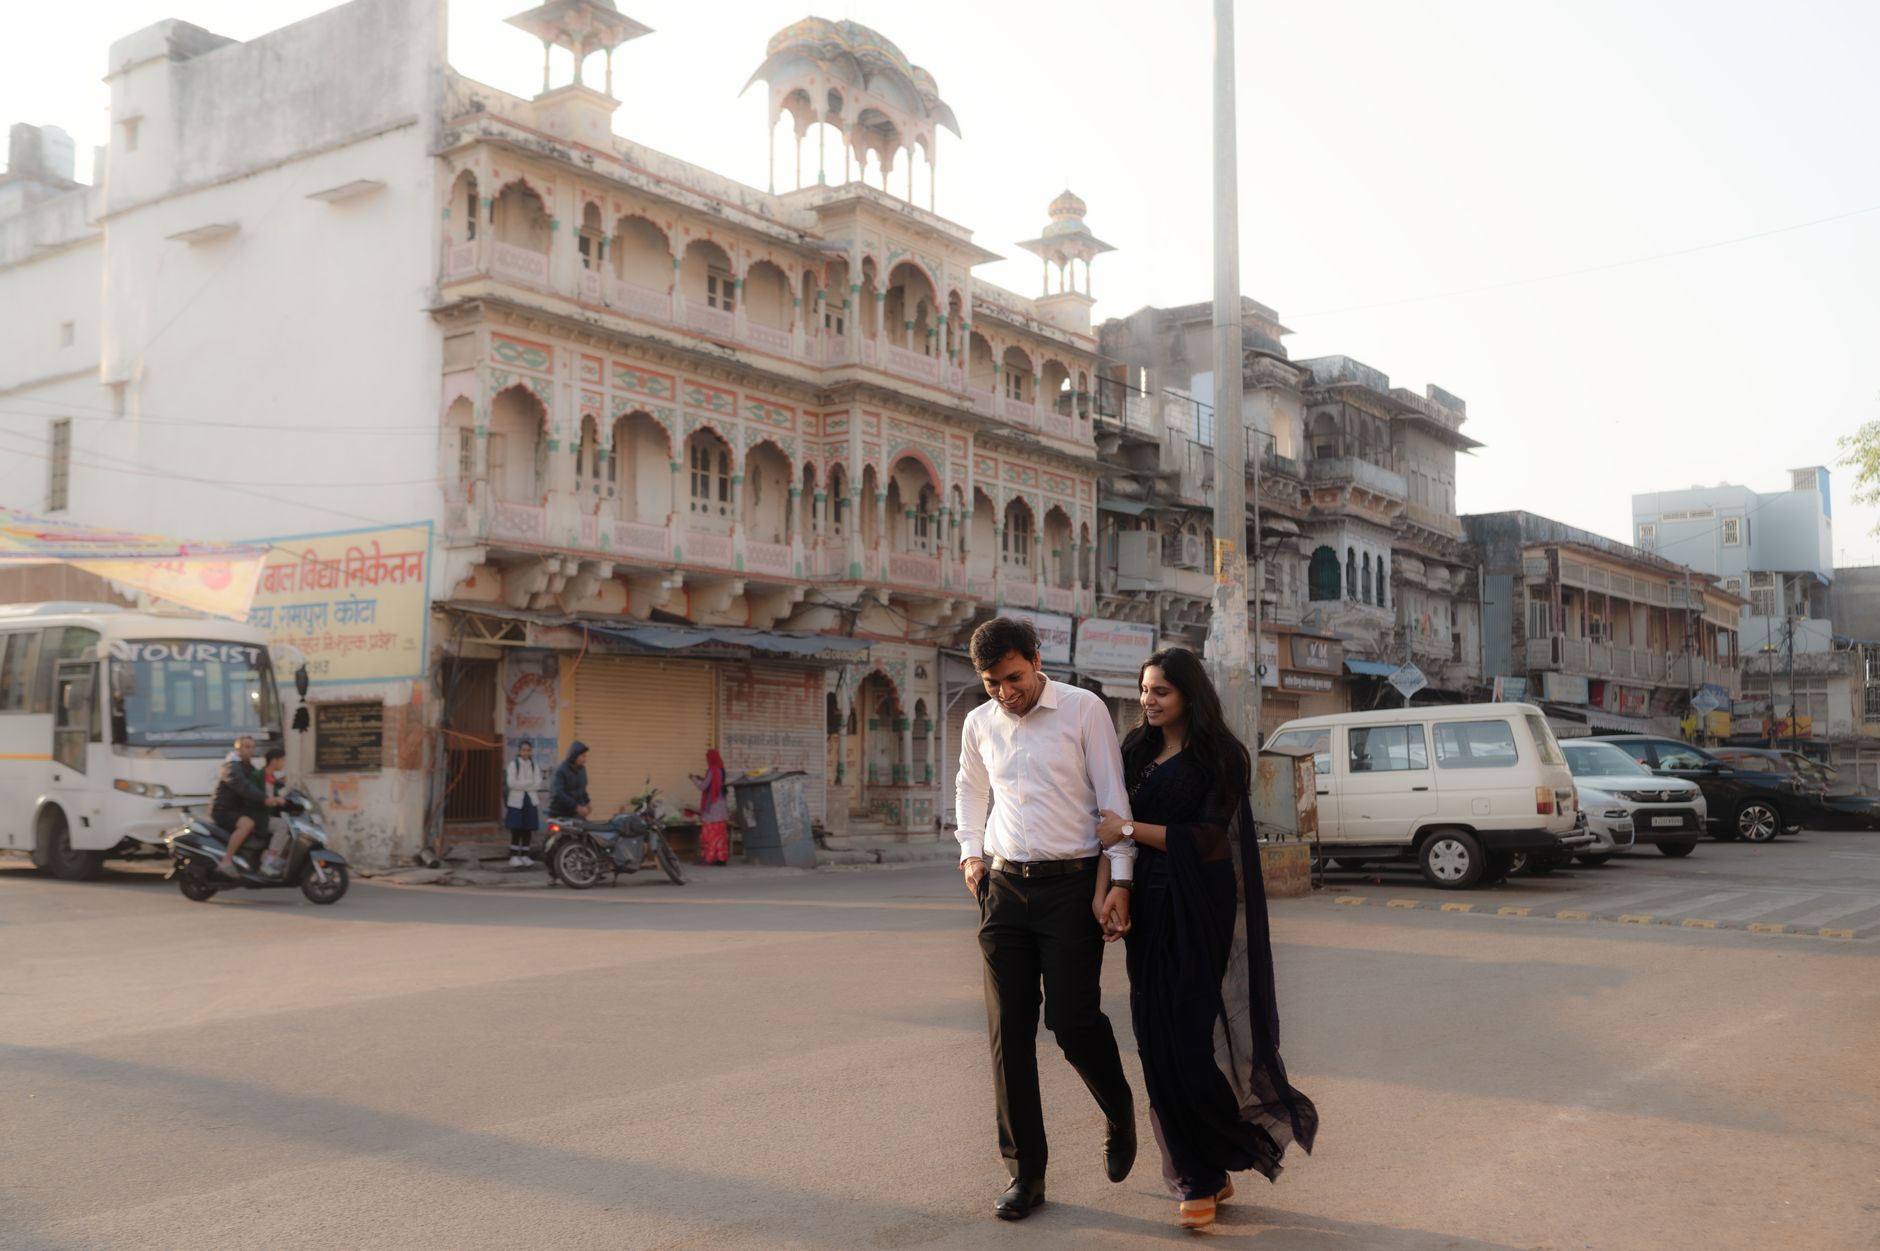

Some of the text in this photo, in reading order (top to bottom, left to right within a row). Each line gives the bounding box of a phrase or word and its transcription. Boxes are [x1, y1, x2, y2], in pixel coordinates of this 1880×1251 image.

[345, 540, 424, 588] निकेतन
[334, 592, 377, 625] कोटा
[127, 643, 262, 664] TOURIST
